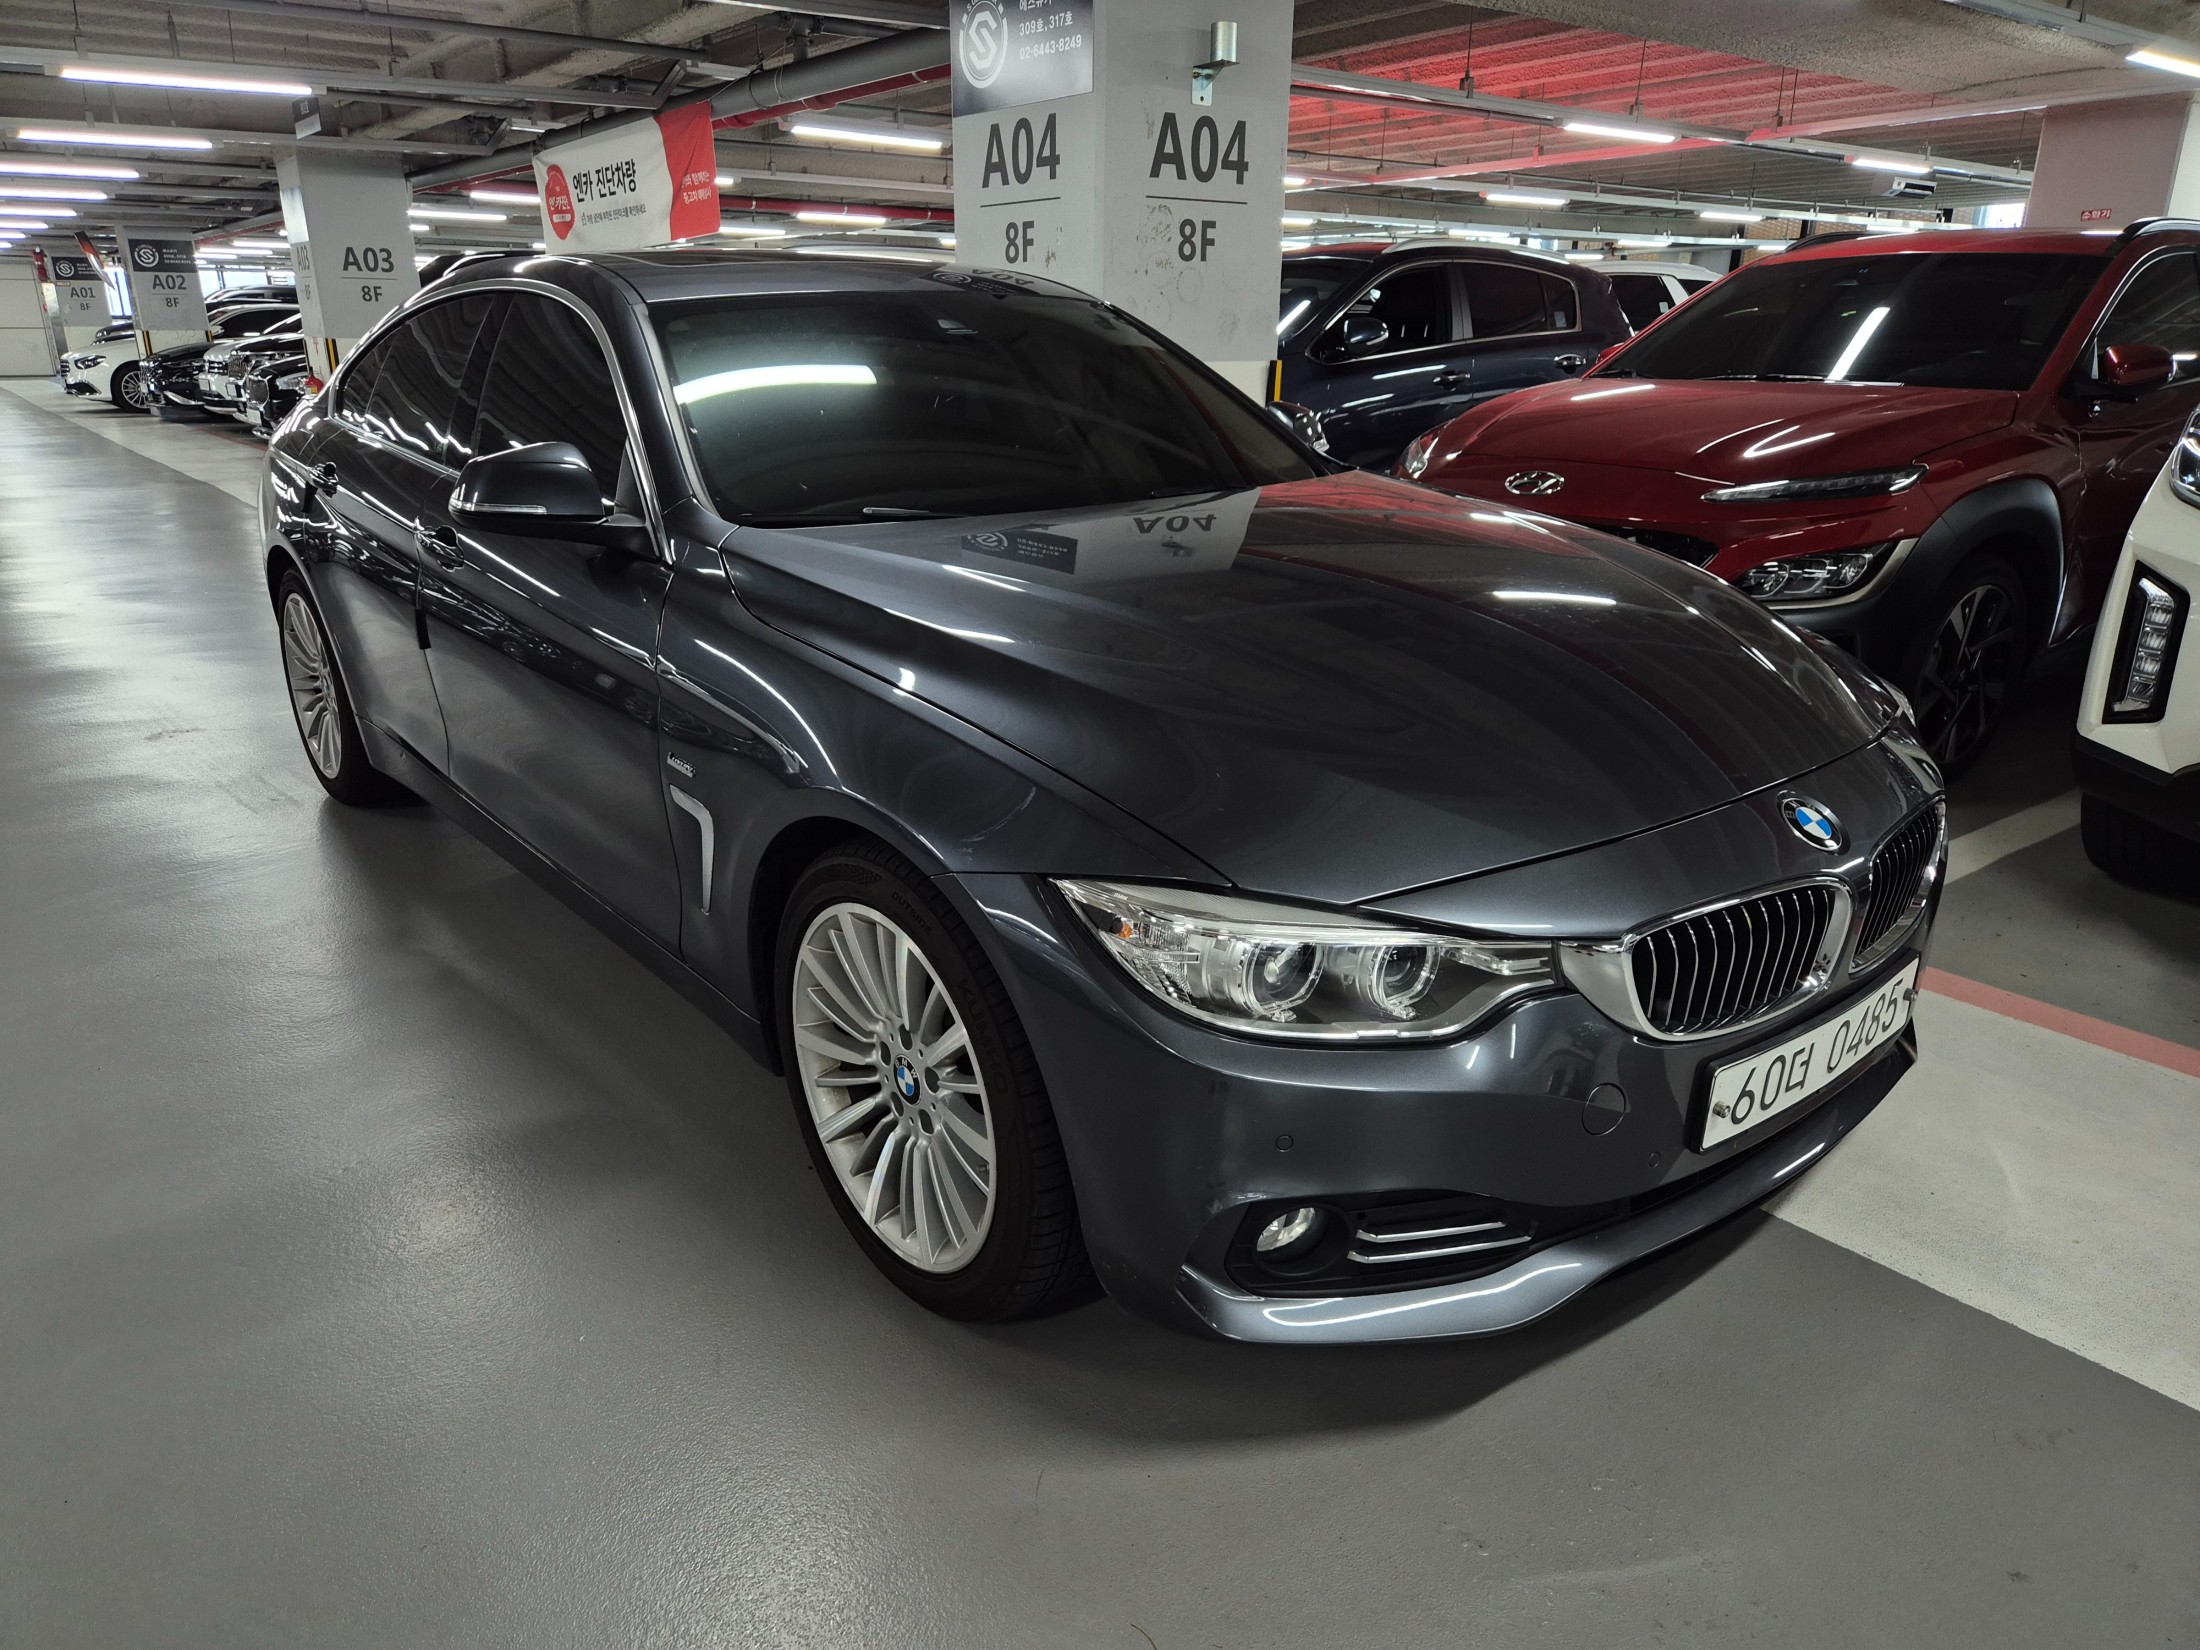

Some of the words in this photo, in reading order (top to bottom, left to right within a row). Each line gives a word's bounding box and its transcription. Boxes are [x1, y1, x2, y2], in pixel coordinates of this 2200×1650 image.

[1049, 11, 1074, 29] 317호
[981, 112, 1061, 189] A04
[1149, 111, 1249, 185] A04
[572, 170, 594, 203] 엔카
[595, 158, 637, 199] 진단차량
[2081, 209, 2111, 220] 소화기
[1004, 220, 1035, 264] 8F
[1178, 218, 1217, 262] 8F
[342, 246, 395, 273] A03
[70, 286, 97, 299] A01
[152, 273, 187, 291] A02
[165, 297, 180, 308] 8F
[361, 285, 383, 302] 8F
[80, 302, 91, 311] 8F
[1730, 1042, 1815, 1125] 60더
[1826, 977, 1904, 1074] 0485
[894, 1057, 918, 1079] BMW
